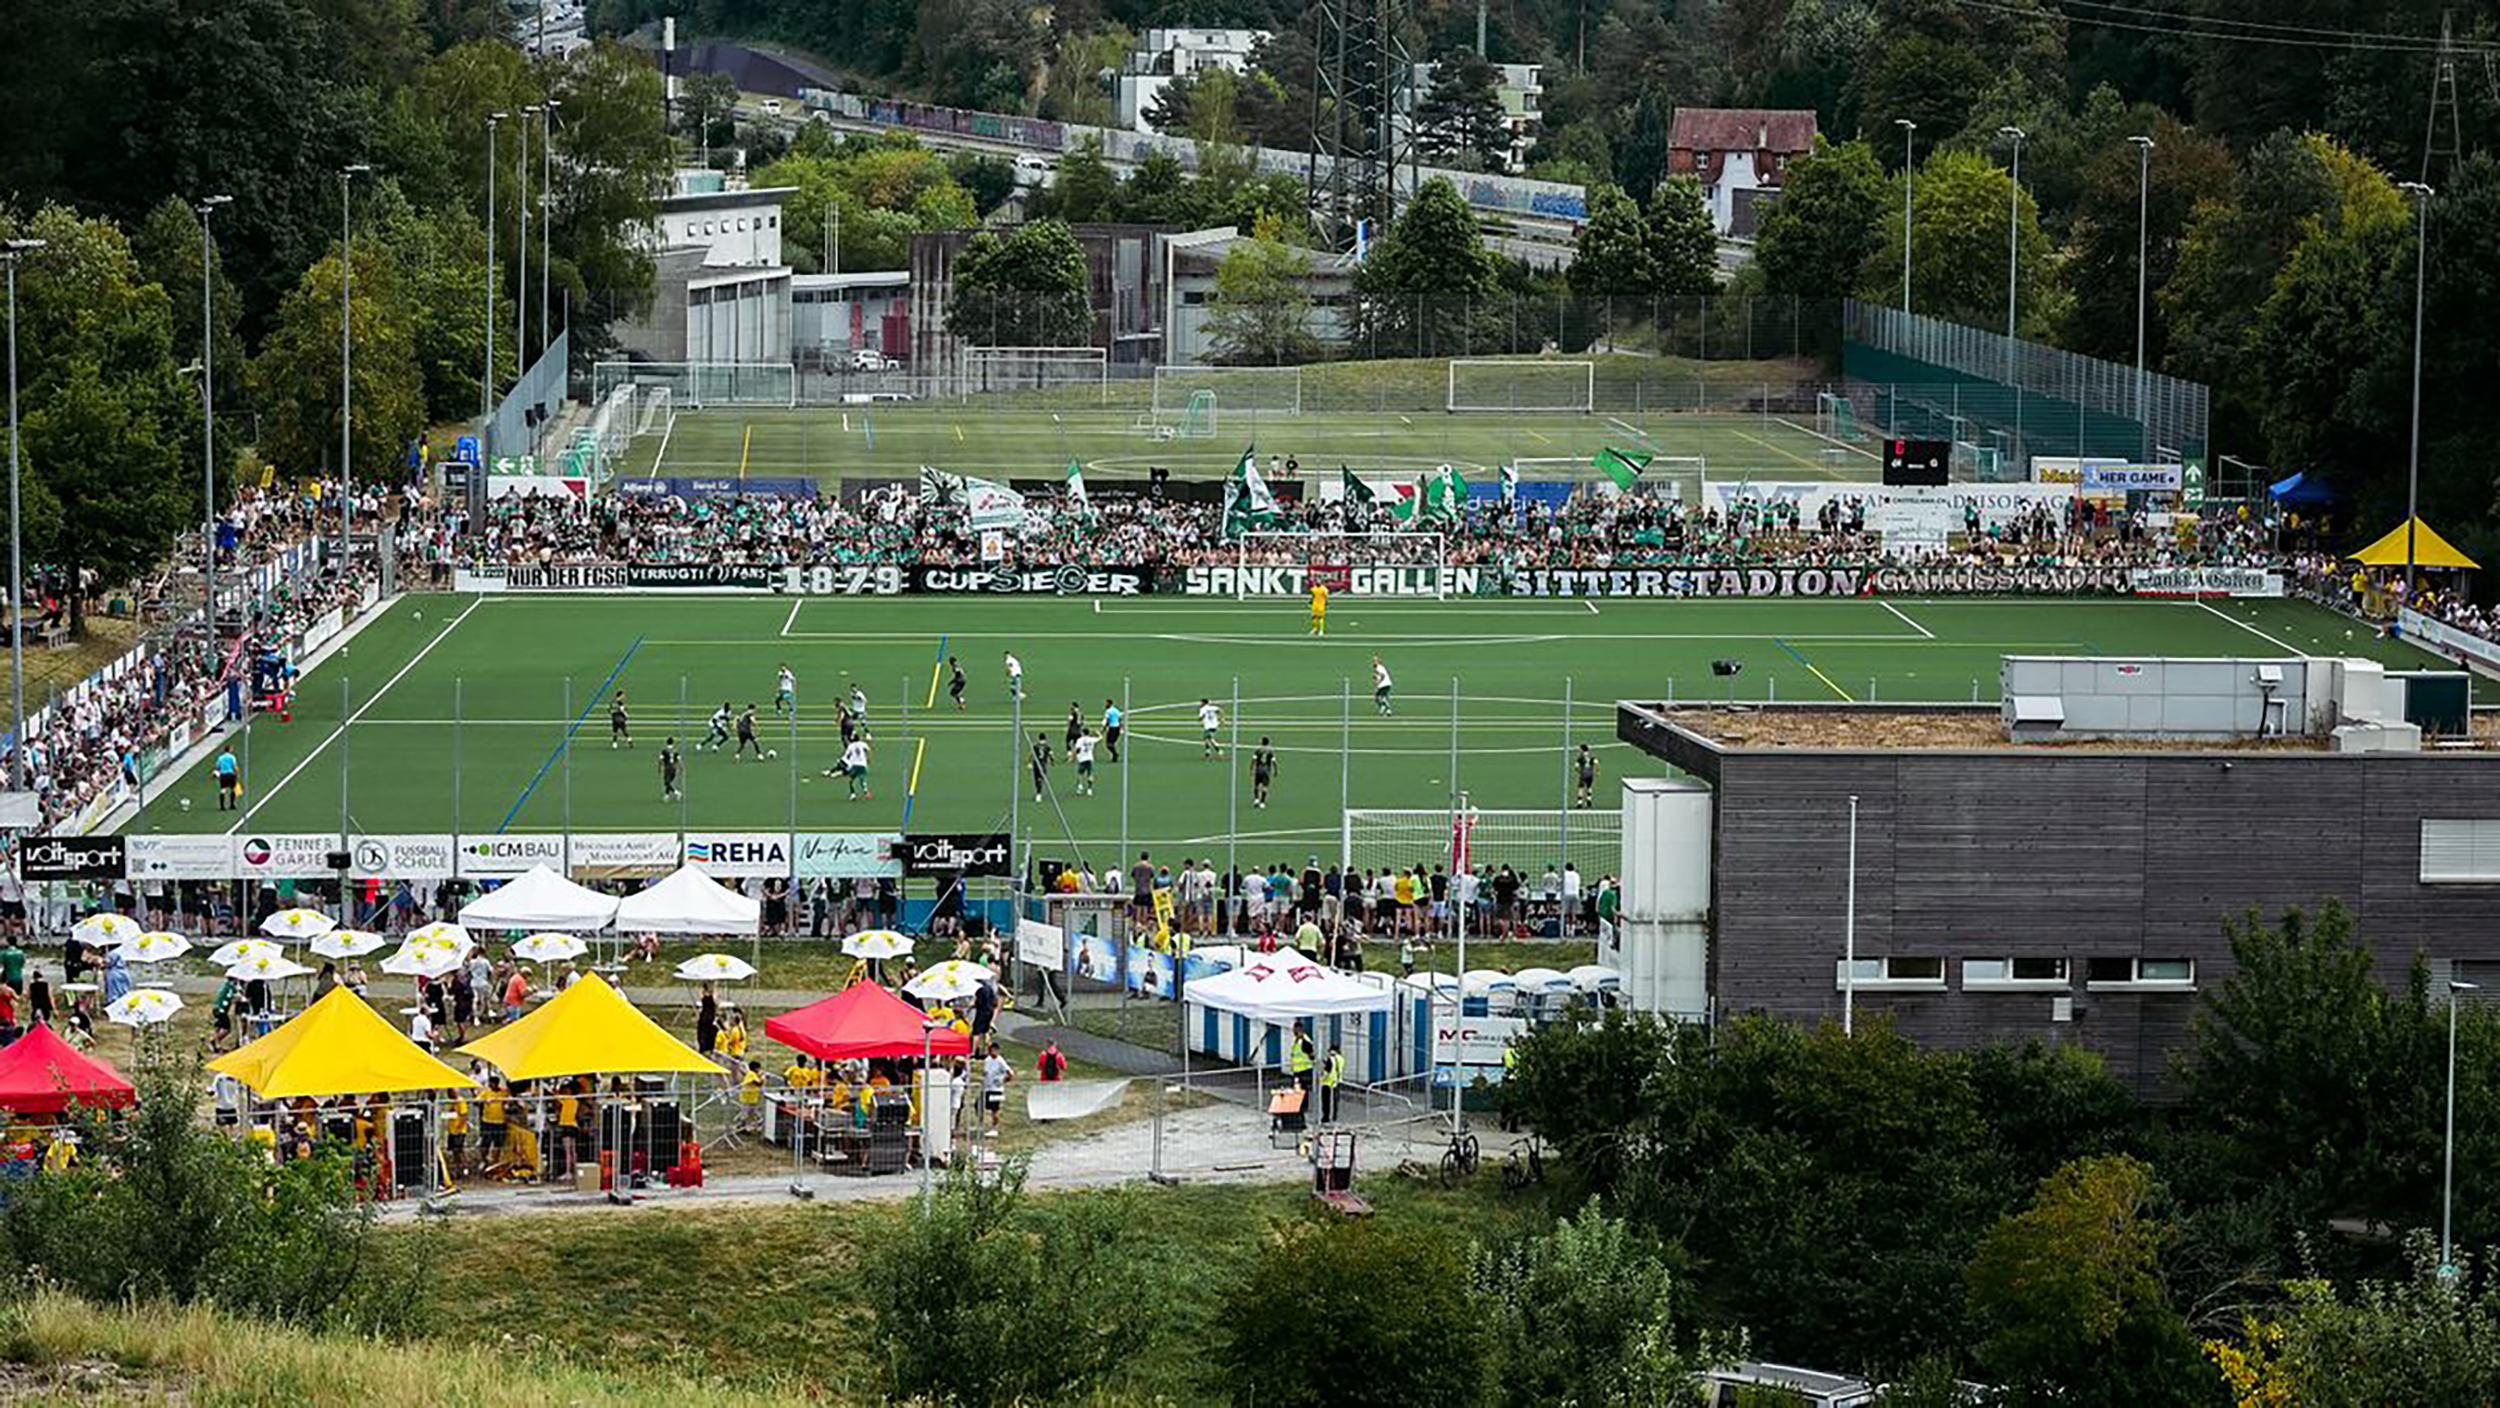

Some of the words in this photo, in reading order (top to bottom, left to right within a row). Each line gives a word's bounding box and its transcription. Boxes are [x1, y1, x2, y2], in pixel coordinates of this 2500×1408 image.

[2100, 473, 2126, 484] HER
[2130, 473, 2167, 484] GAME
[506, 566, 543, 587] NUR
[550, 566, 580, 587] DER
[924, 564, 1140, 593] CUPSIEGER
[1186, 566, 1309, 594] SANKT
[1350, 566, 1479, 594] GALLEN
[1510, 569, 1861, 596] SITTERSTADION
[275, 838, 333, 850] FENNER
[395, 846, 446, 857] FUSSBALL
[712, 842, 786, 862] REHA
[395, 857, 446, 869] SCHULE
